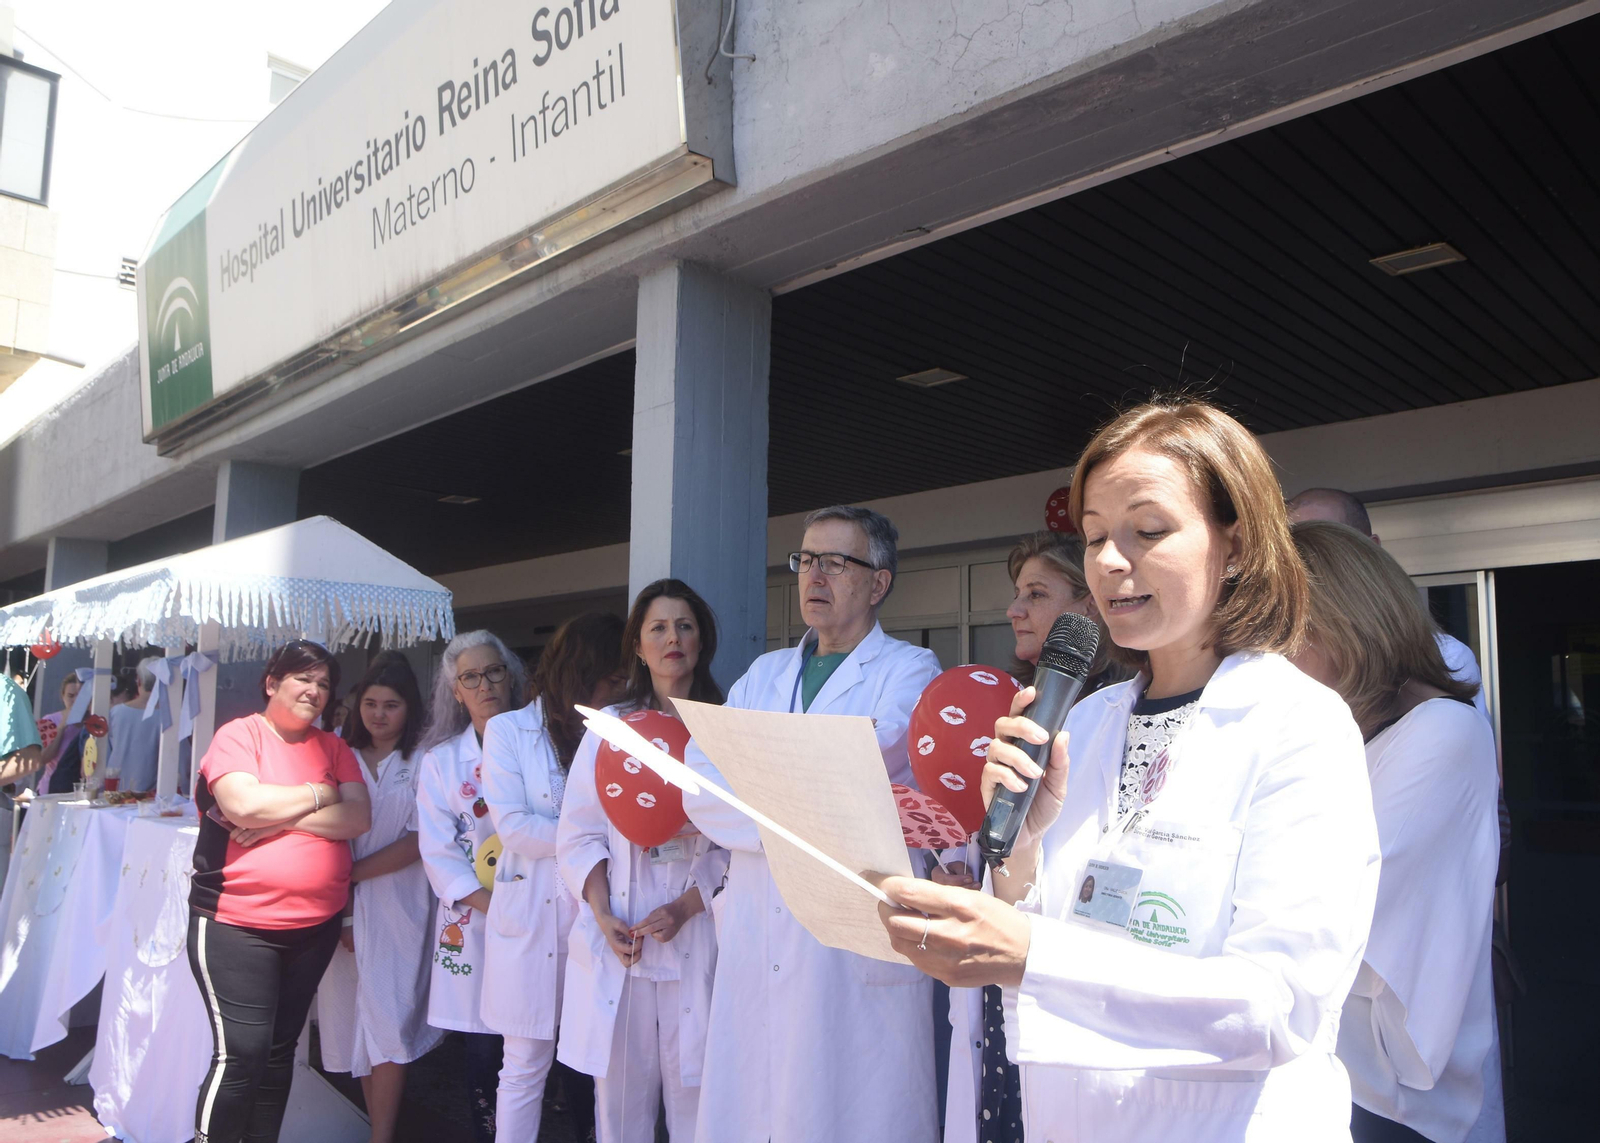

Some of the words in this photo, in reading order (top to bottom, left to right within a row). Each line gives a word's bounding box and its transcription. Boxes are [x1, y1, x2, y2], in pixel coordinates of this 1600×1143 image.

[220, 207, 285, 292] Hospital
[292, 110, 426, 238] Universitario
[437, 48, 518, 136] Reina
[372, 158, 475, 249] Materno
[511, 42, 626, 163] Infantil
[156, 362, 171, 384] JUNTA
[171, 358, 178, 375] DE
[1142, 920, 1151, 929] DE
